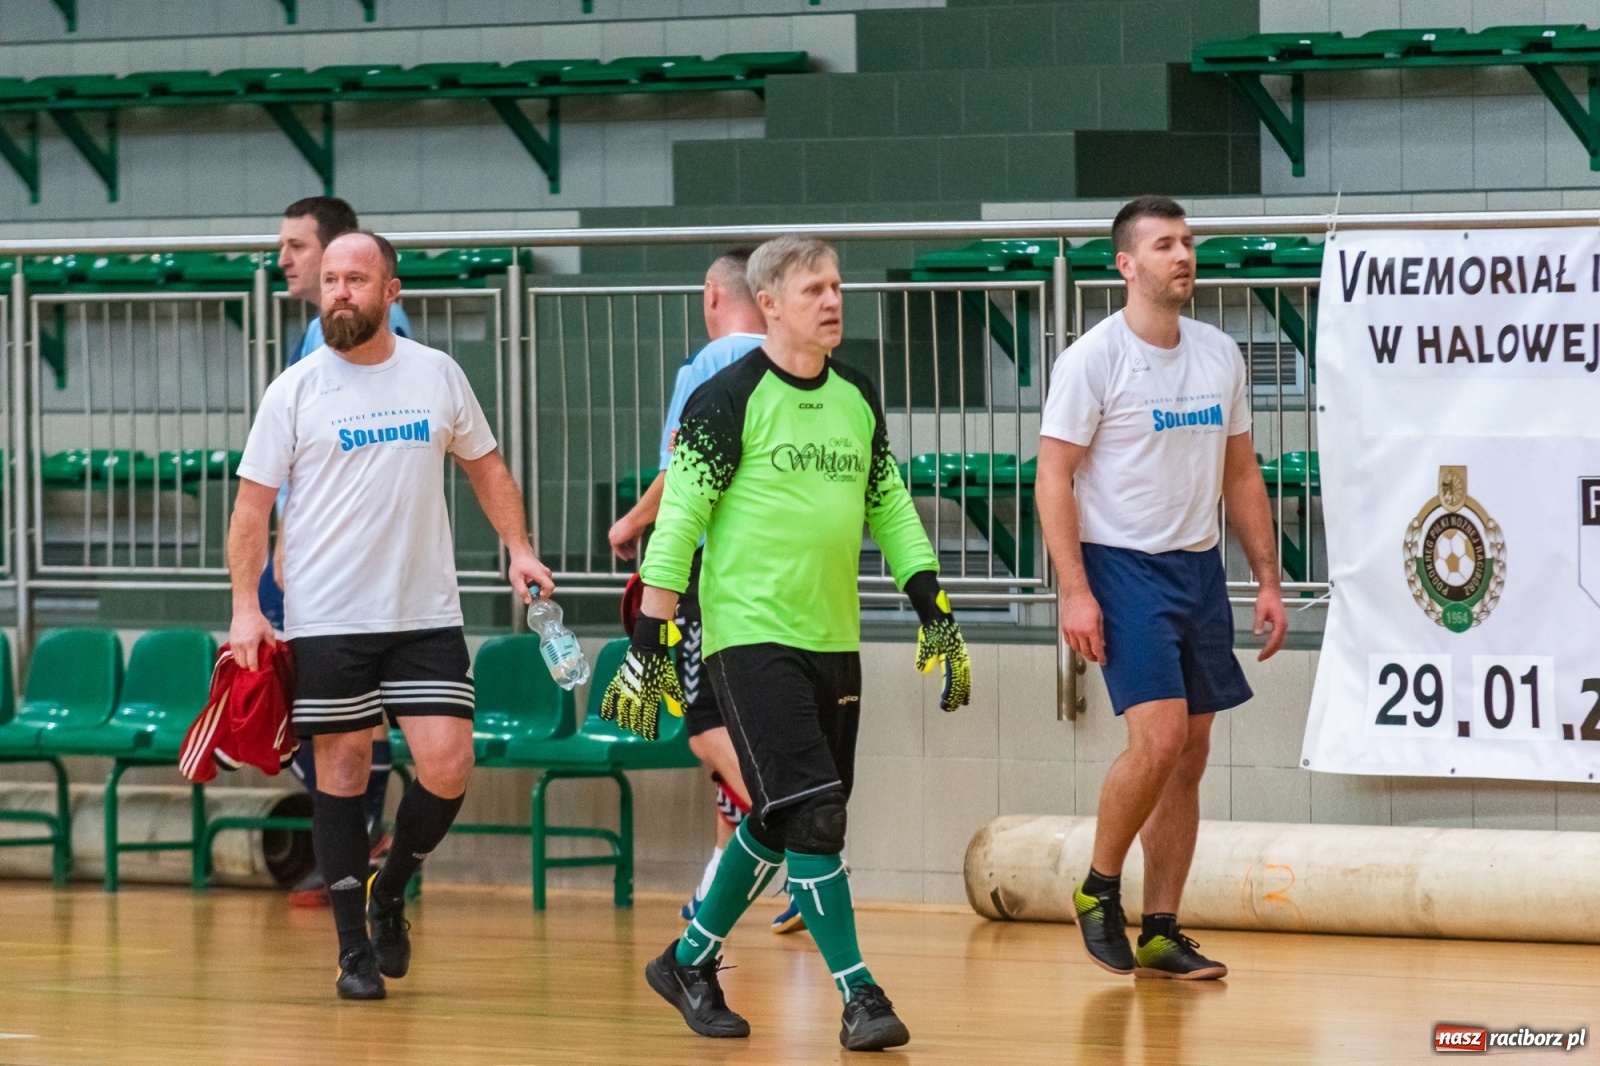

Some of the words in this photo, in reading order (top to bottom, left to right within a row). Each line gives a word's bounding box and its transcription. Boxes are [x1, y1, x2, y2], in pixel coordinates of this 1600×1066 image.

[1367, 255, 1576, 295] MEMORIAŁ
[1368, 325, 1403, 363] W
[1417, 323, 1600, 373] HALOWEJ
[1152, 403, 1223, 432] SOLIDUM
[339, 419, 430, 451] SOLIDUM
[1446, 611, 1468, 625] 1964
